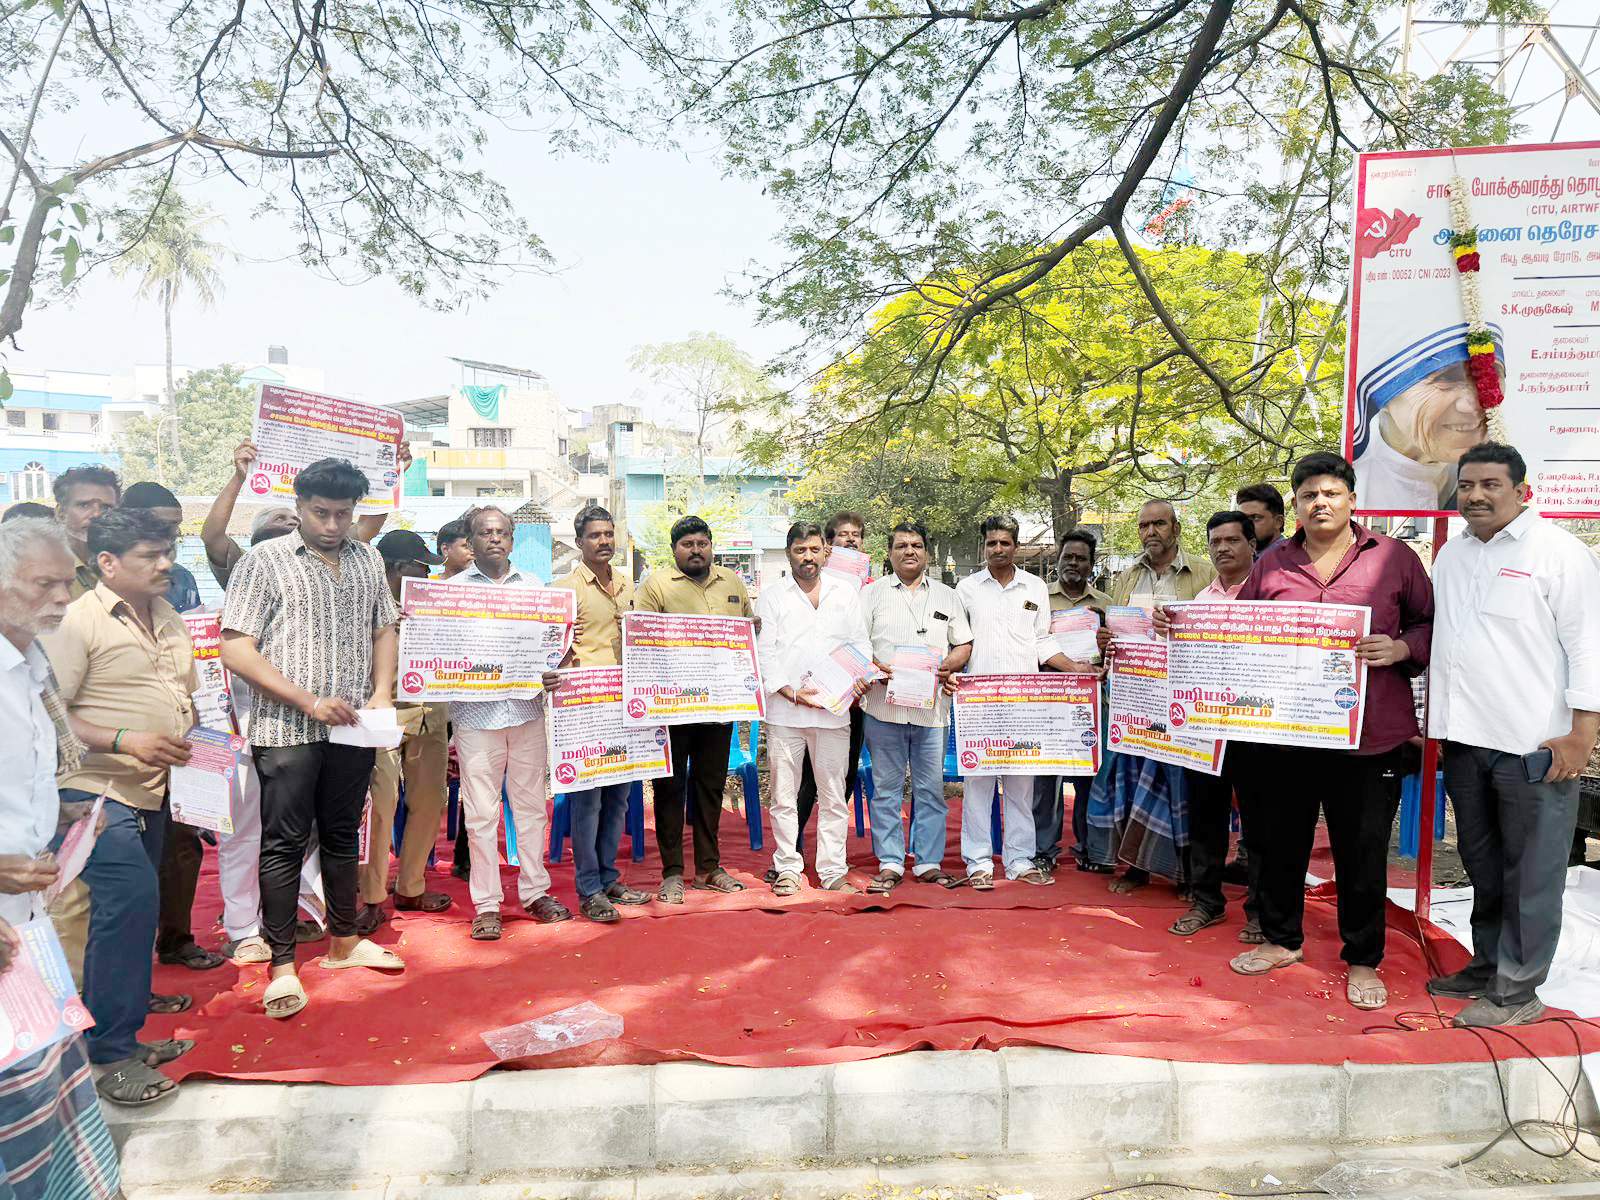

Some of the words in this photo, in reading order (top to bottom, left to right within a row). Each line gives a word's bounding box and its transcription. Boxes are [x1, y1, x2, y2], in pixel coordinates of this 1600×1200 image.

[1472, 175, 1564, 200] போக்குவரத்து
[1560, 203, 1599, 214] AIRTWF
[1528, 220, 1600, 245] தெரேச
[1389, 249, 1411, 258] CITU
[1521, 253, 1549, 264] ஆவடி
[1392, 269, 1412, 280] 00052
[1418, 268, 1431, 279] CNI
[1501, 302, 1573, 317] S.K.முருகேஷ்
[1553, 335, 1589, 346] தலைவர்
[1531, 348, 1600, 361] E.சம்பத்குமா
[259, 462, 303, 477] மறிய
[1193, 622, 1219, 630] அகில
[1220, 622, 1253, 632] இந்திய
[1254, 624, 1282, 634] பொது
[1283, 624, 1315, 633] வேலை
[1316, 626, 1356, 637] நிறுத்தம்
[1202, 632, 1262, 643] போக்குவரத்து
[1264, 635, 1319, 644] வாகனங்கள்
[1321, 637, 1350, 648] ஓடாது
[409, 656, 472, 674] மறியல்
[434, 671, 500, 682] போராட்டம்
[633, 682, 682, 699] மறியல்
[1173, 687, 1237, 704] மறியல்
[654, 694, 709, 706] போராட்டம்
[1195, 701, 1272, 717] போராட்டம்
[1113, 713, 1152, 728] மறியல்
[1128, 724, 1172, 742] போராட்டம்
[561, 741, 607, 762] மறியல்
[965, 736, 1015, 752] மறியல்
[584, 752, 627, 768] போராட்டம்
[986, 748, 1041, 759] போராட்டம்
